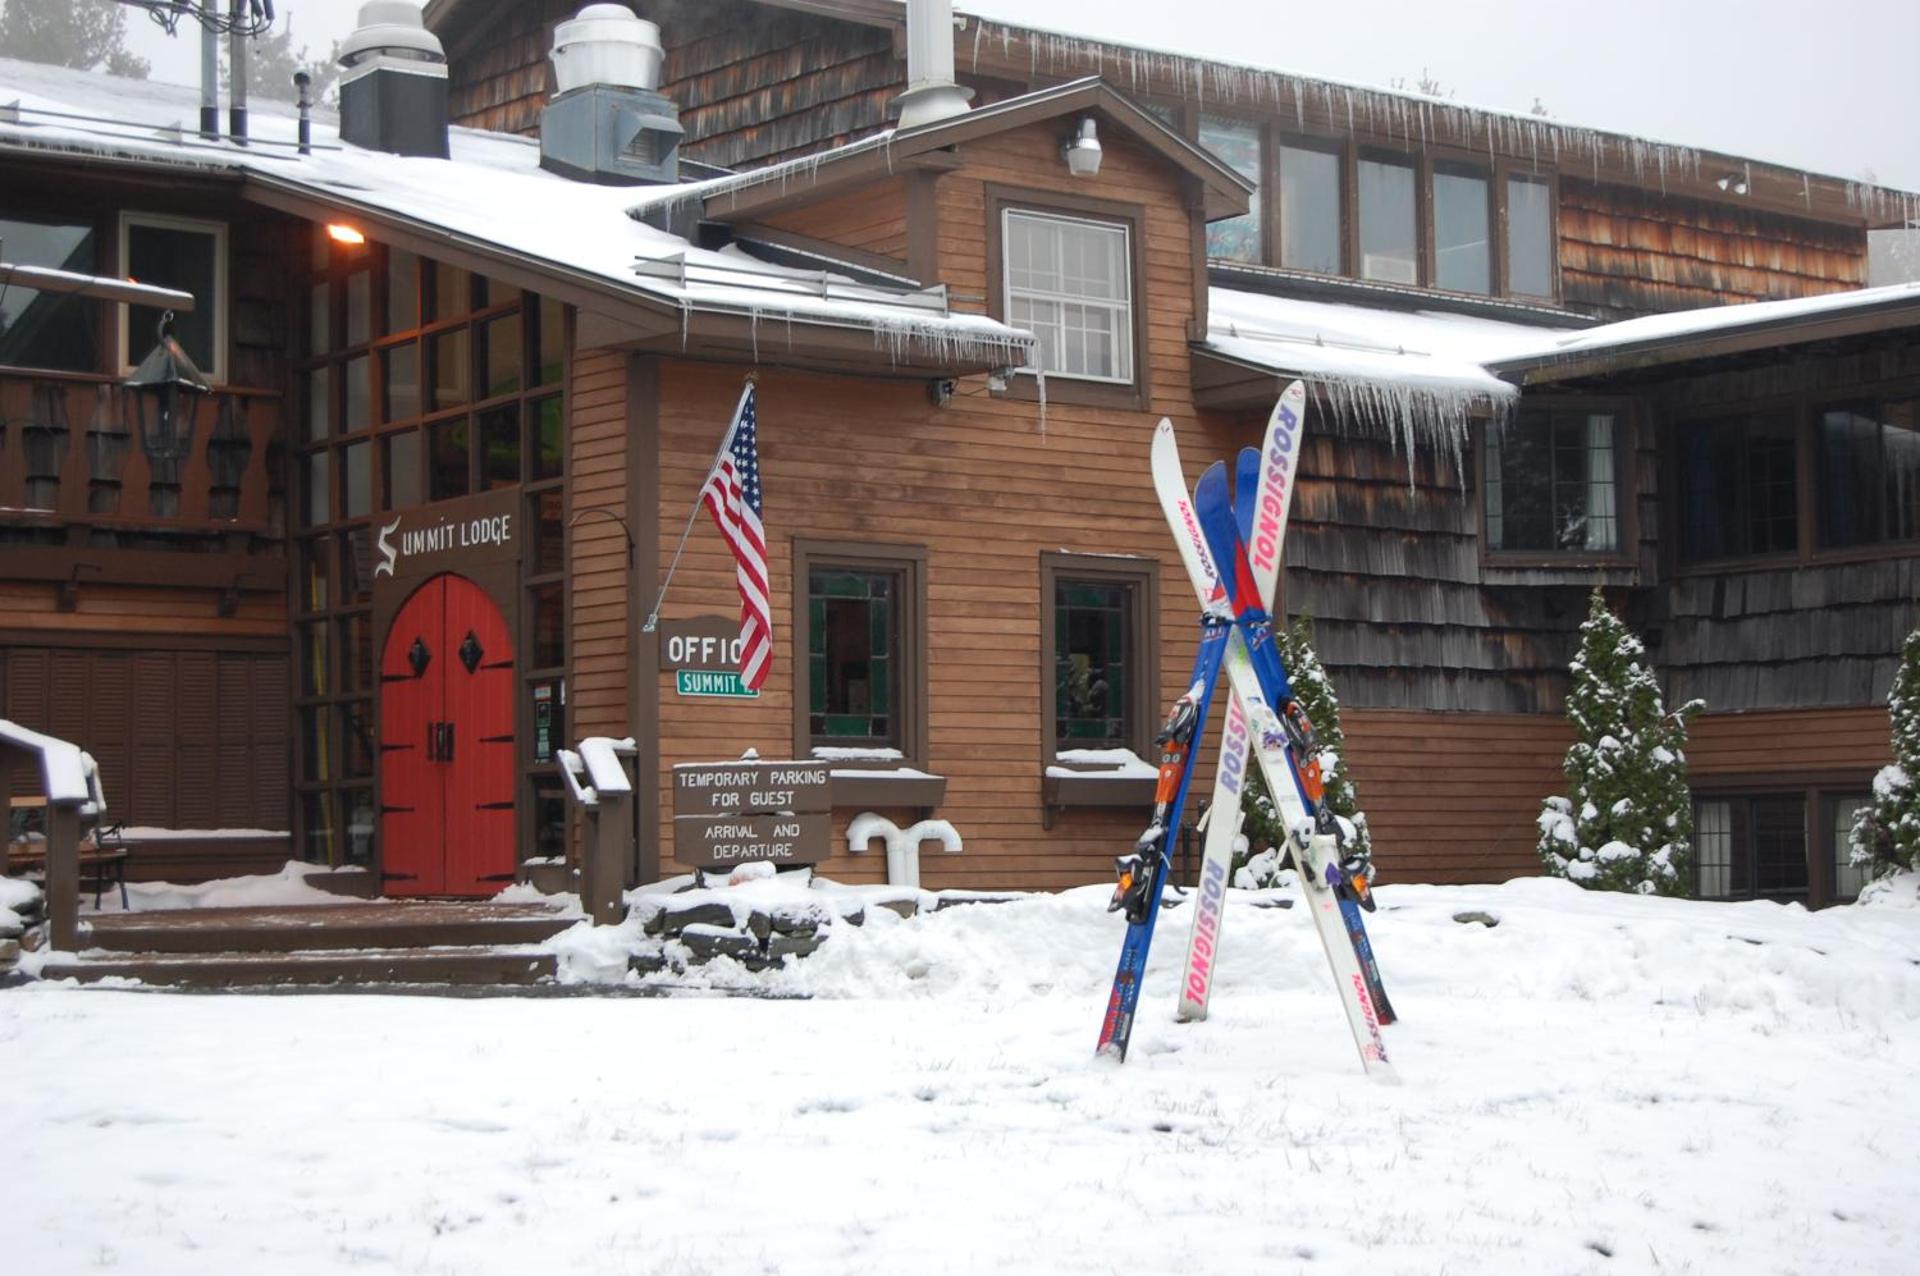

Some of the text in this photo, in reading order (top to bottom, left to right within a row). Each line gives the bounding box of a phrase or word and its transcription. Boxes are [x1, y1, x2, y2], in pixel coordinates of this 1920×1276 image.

[1253, 403, 1298, 572] ROSSIGNOL
[461, 514, 511, 547] LODGE
[668, 636, 742, 664] OFFIC
[684, 673, 737, 693] SUMMIT
[679, 770, 826, 787] TEMPORARY PARKING
[712, 791, 794, 807] FOR GUEST
[704, 823, 800, 839] ARRIVAL AND
[713, 843, 793, 859] DEPARTURE
[1186, 857, 1225, 1006] ROSSIGNOL
